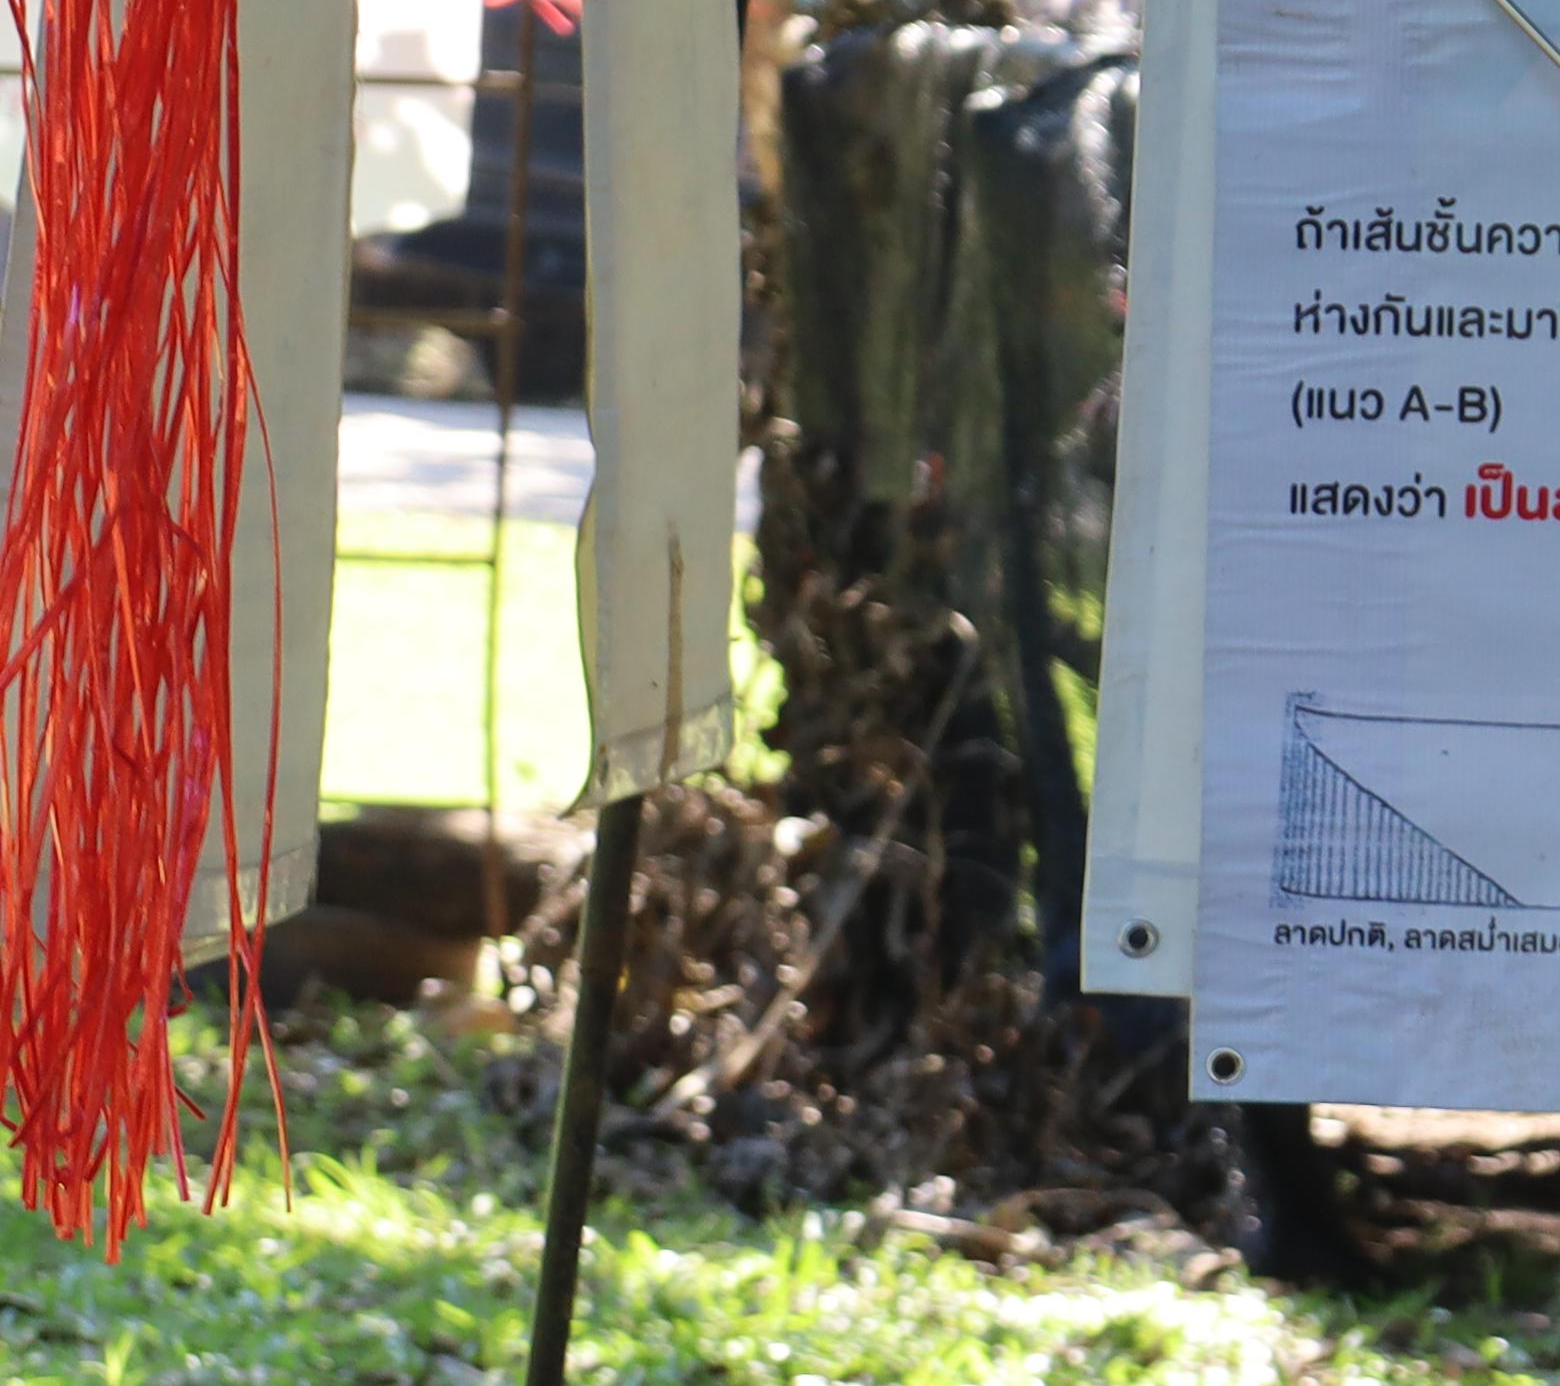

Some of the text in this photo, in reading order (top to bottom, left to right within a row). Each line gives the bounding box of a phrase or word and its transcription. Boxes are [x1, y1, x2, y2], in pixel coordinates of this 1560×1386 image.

[1291, 380, 1503, 433] (แนว A-B)
[1290, 471, 1446, 519] แสดงว่า
[1273, 919, 1395, 952] ลาดปกติ,
